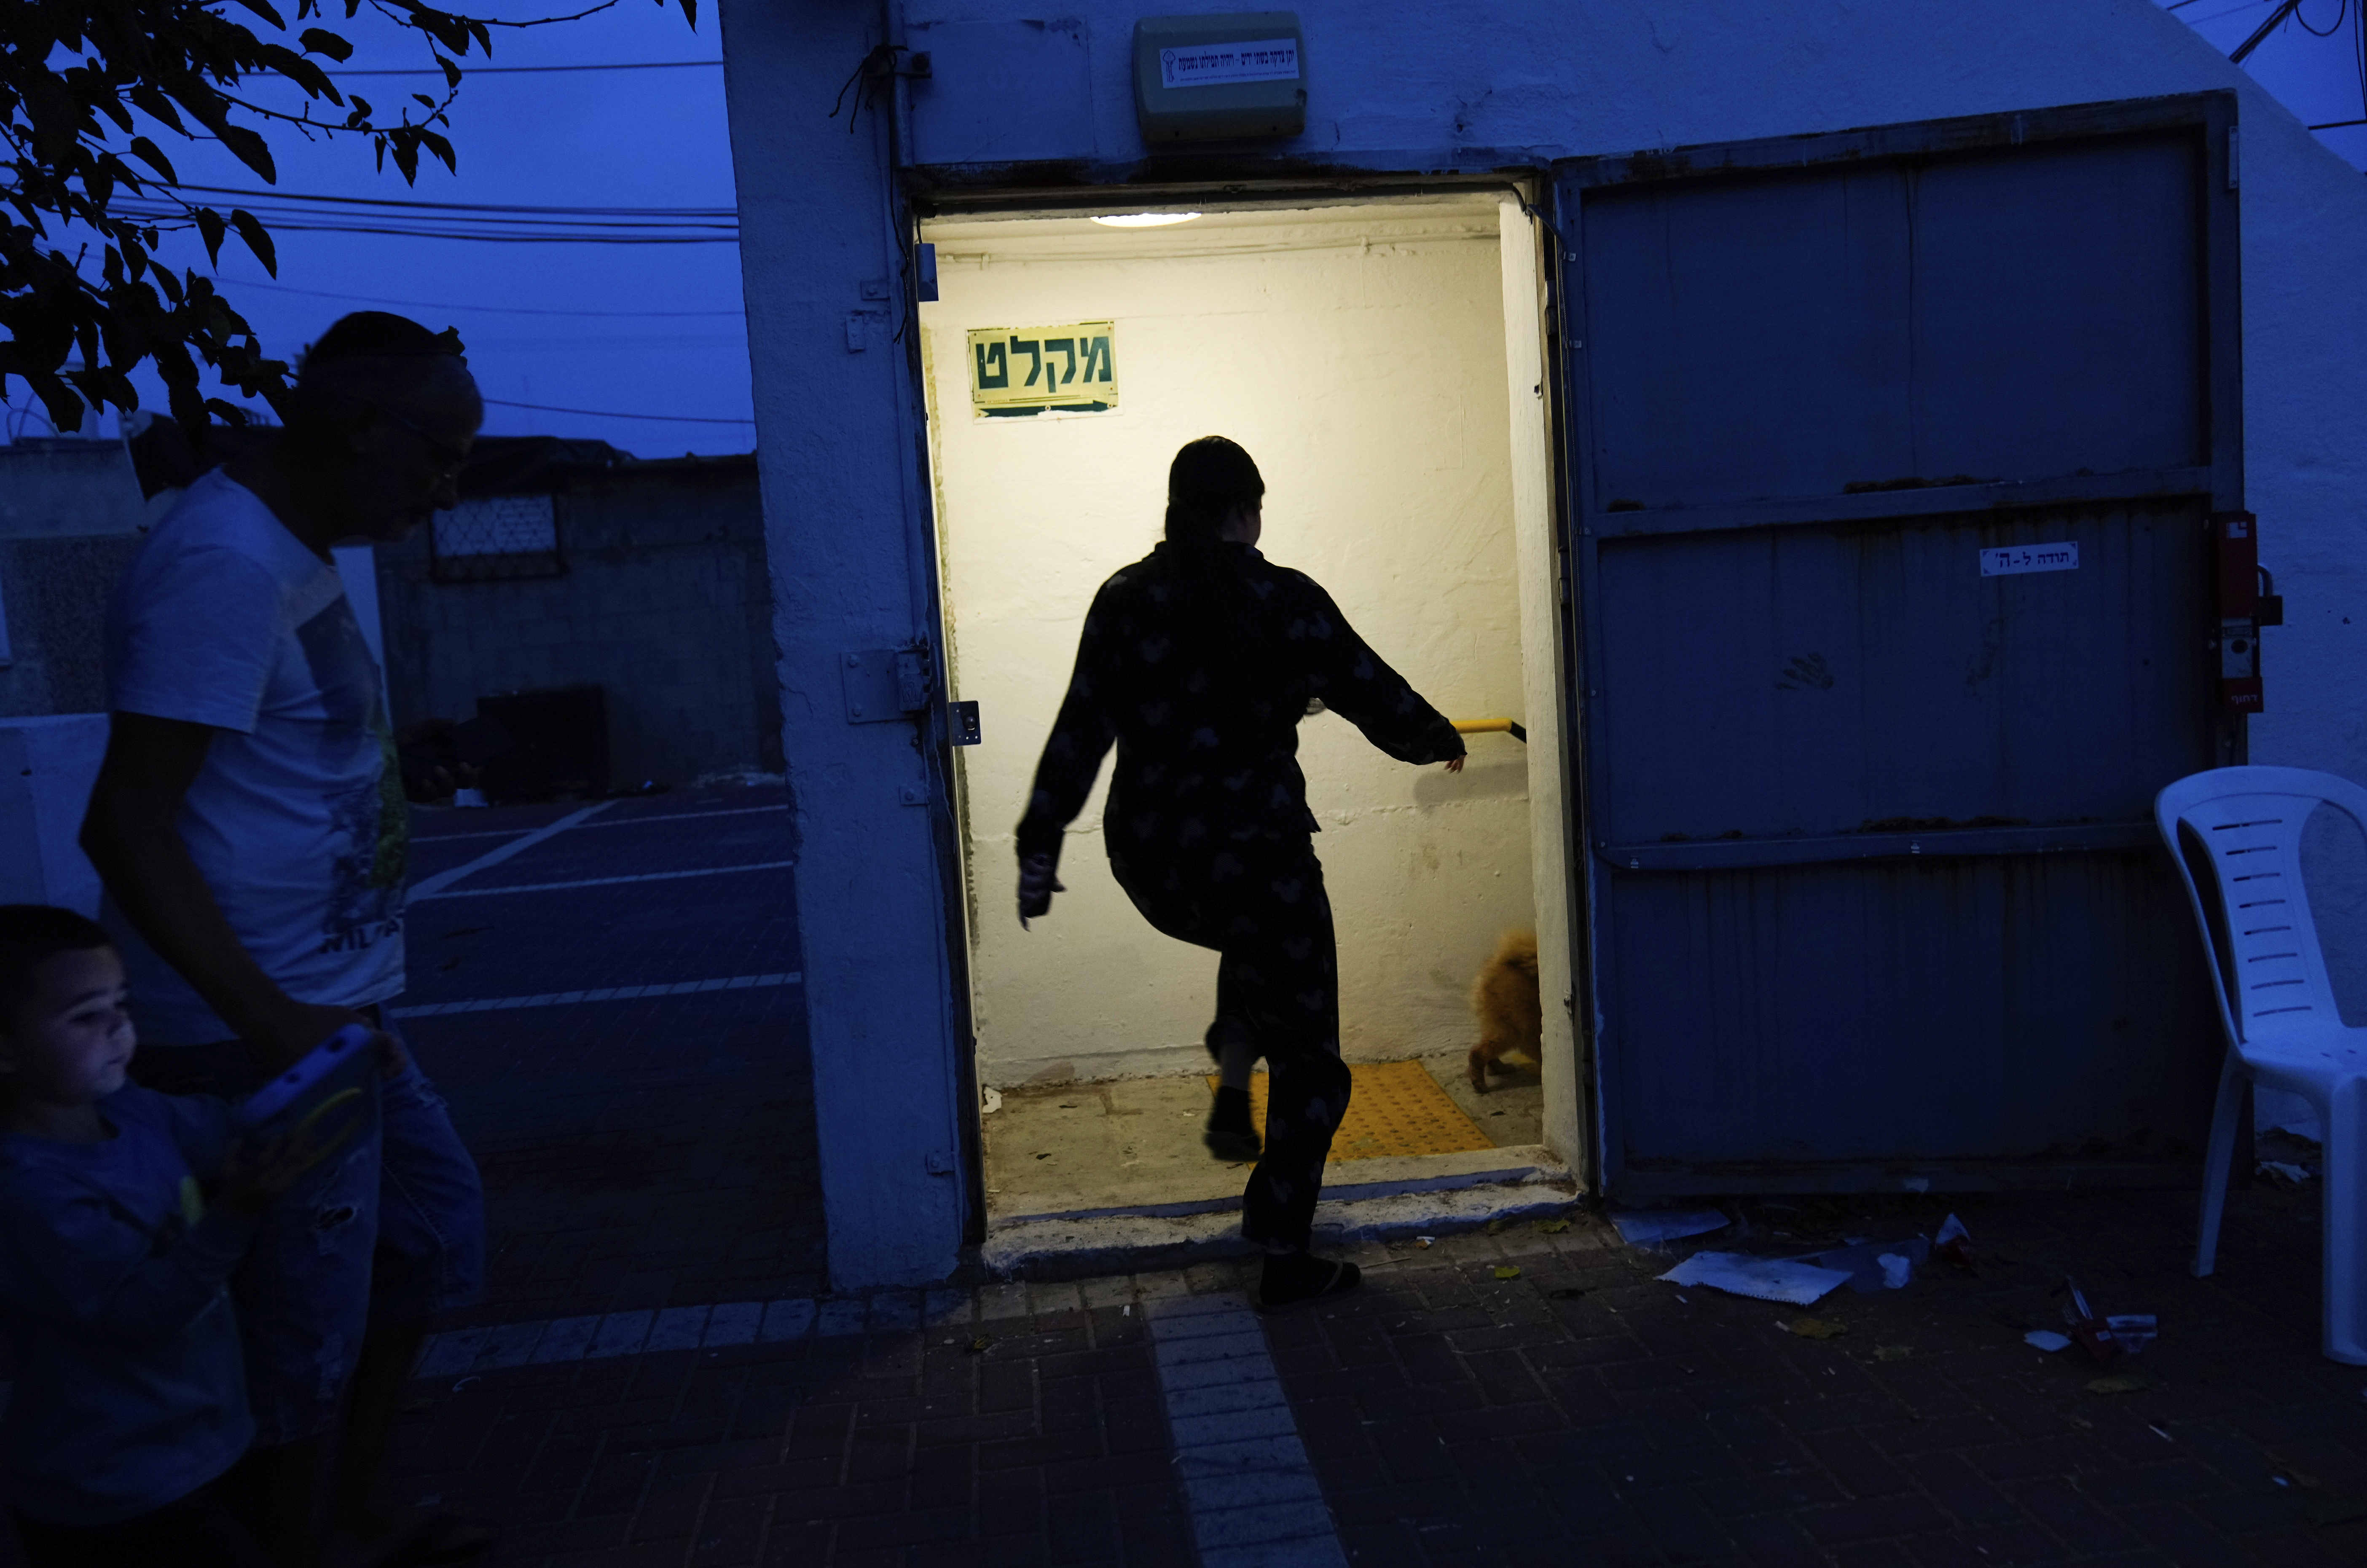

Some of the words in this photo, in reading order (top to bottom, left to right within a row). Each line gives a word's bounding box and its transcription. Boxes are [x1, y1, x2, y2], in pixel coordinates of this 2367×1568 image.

[1178, 56, 1197, 72] נשמעת
[1199, 51, 1219, 68] תפילתו
[1220, 54, 1234, 67] ויהיה
[1241, 52, 1252, 66] ידים
[1254, 51, 1269, 65] בשתי
[1270, 50, 1285, 67] צדקה
[976, 336, 1112, 393] מקלט
[2038, 552, 2069, 564] תודה
